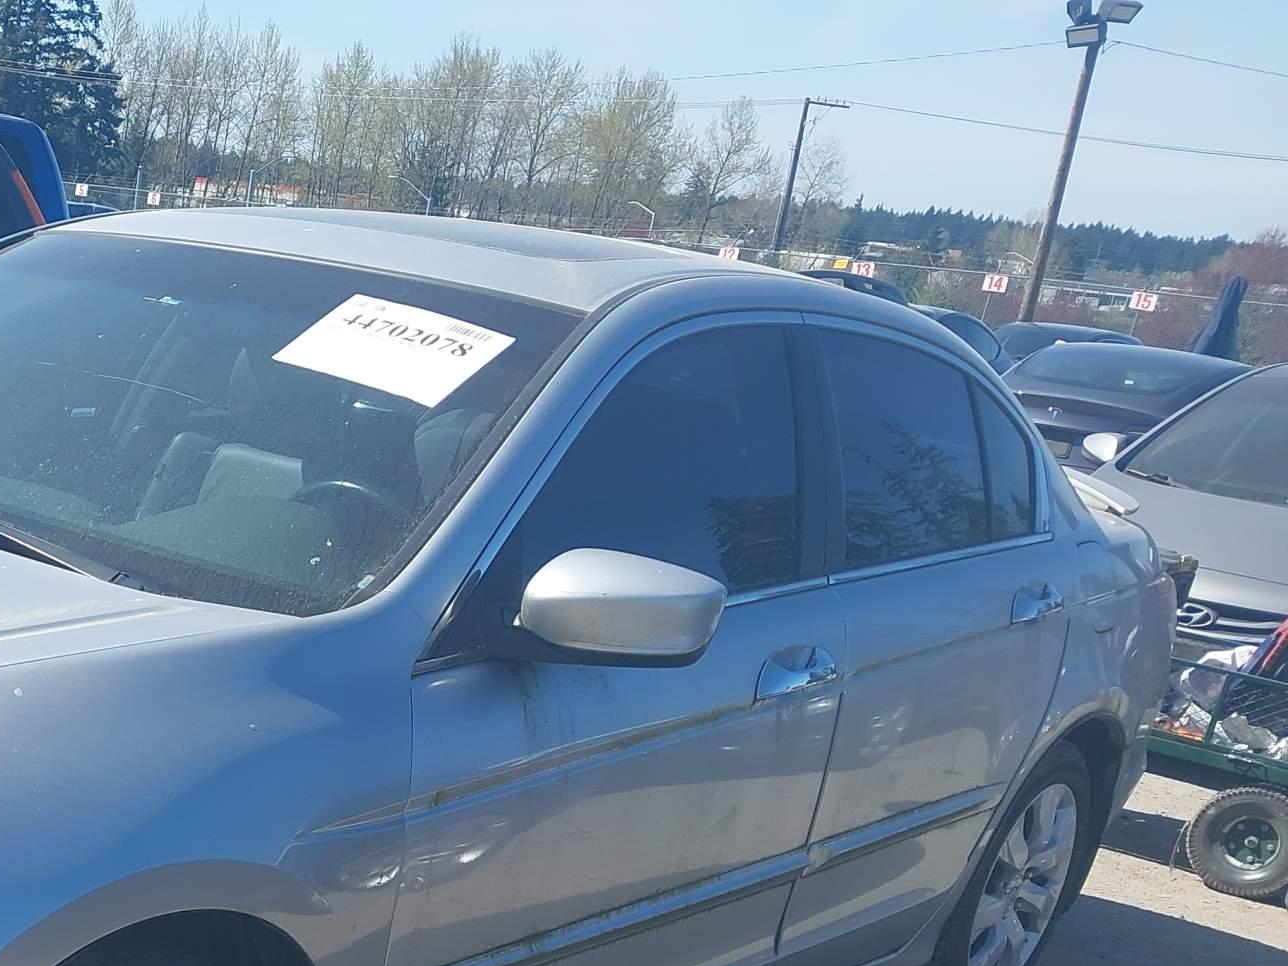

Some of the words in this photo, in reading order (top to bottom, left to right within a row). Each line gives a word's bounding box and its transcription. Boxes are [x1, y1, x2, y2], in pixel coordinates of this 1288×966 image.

[856, 263, 870, 276] 13
[988, 276, 1003, 291] 14
[1137, 294, 1152, 309] 15
[341, 313, 474, 358] 44702078
